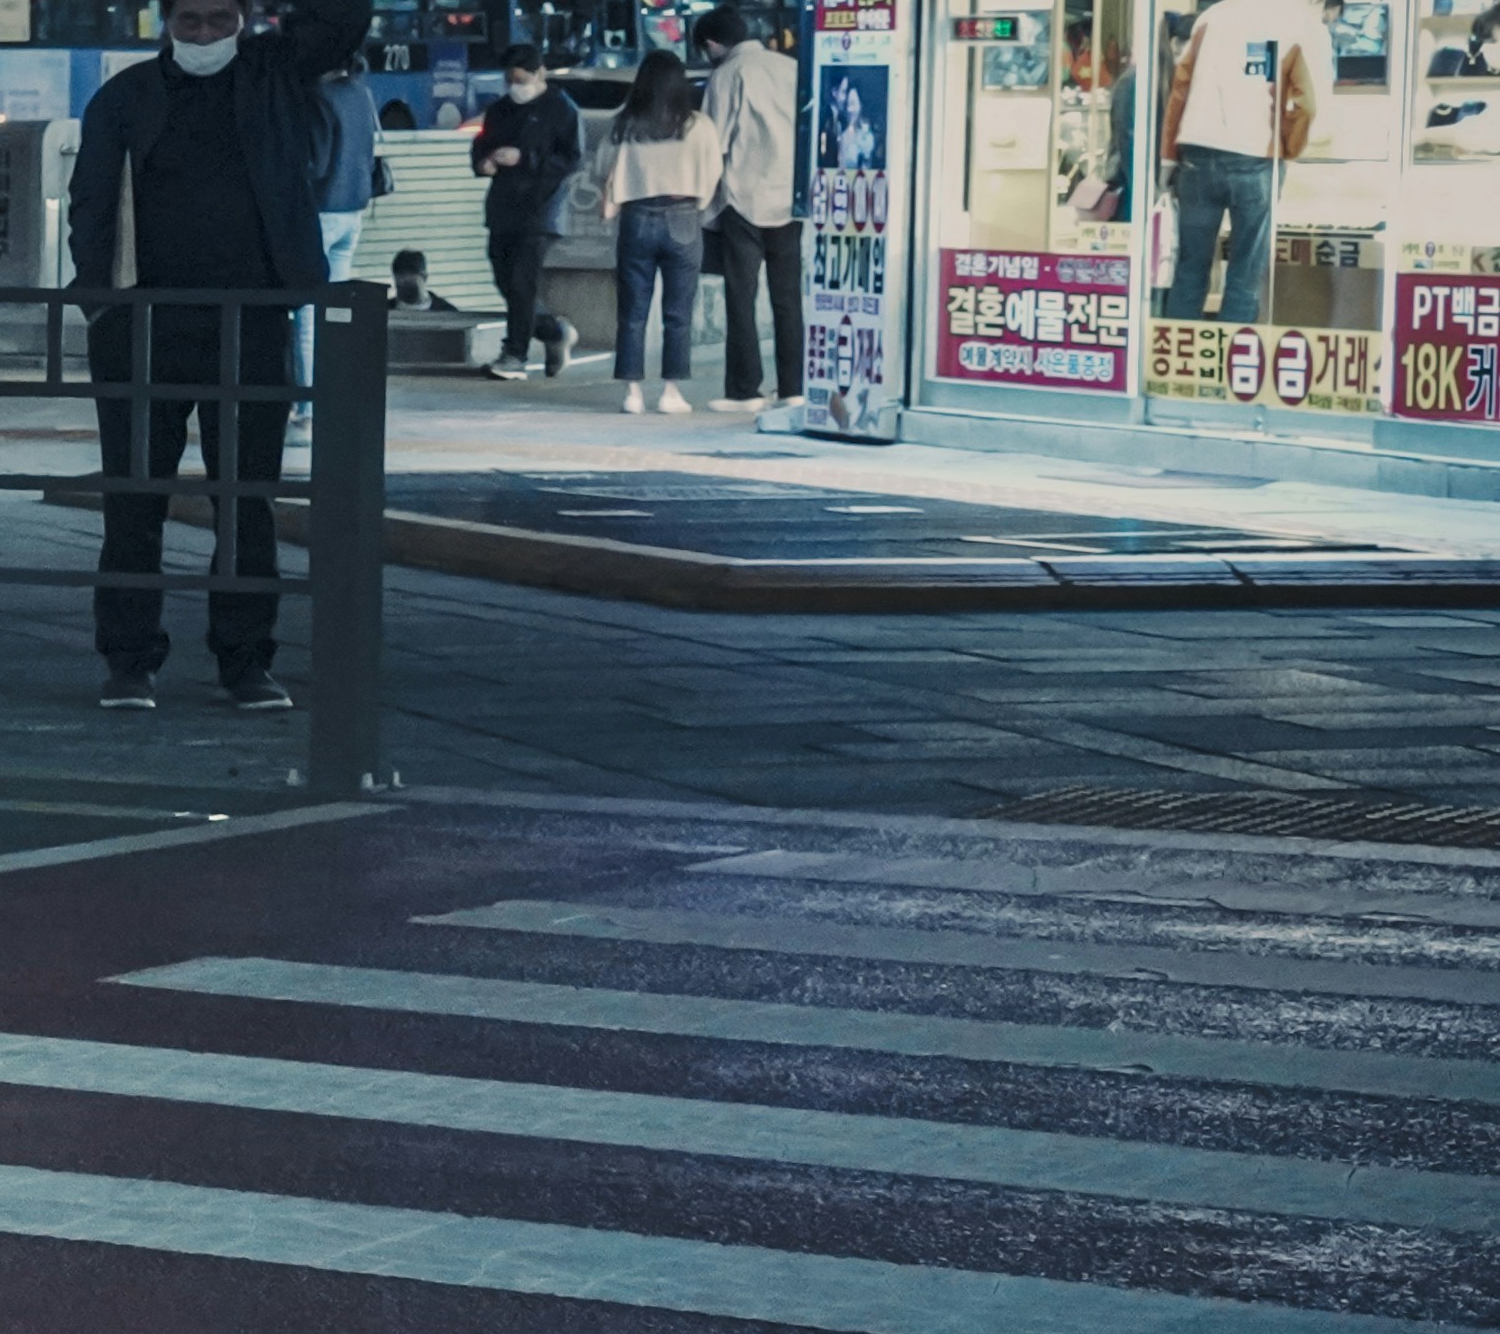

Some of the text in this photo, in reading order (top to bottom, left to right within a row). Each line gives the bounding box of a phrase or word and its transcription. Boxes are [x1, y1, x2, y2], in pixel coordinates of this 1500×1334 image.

[955, 253, 1040, 281] 결혼기념일
[947, 286, 1129, 347] 결혼예물전문
[1412, 285, 1500, 337] PT백금
[1151, 326, 1196, 377] 종로
[1231, 333, 1259, 395] 금
[1401, 342, 1462, 411] 18K
